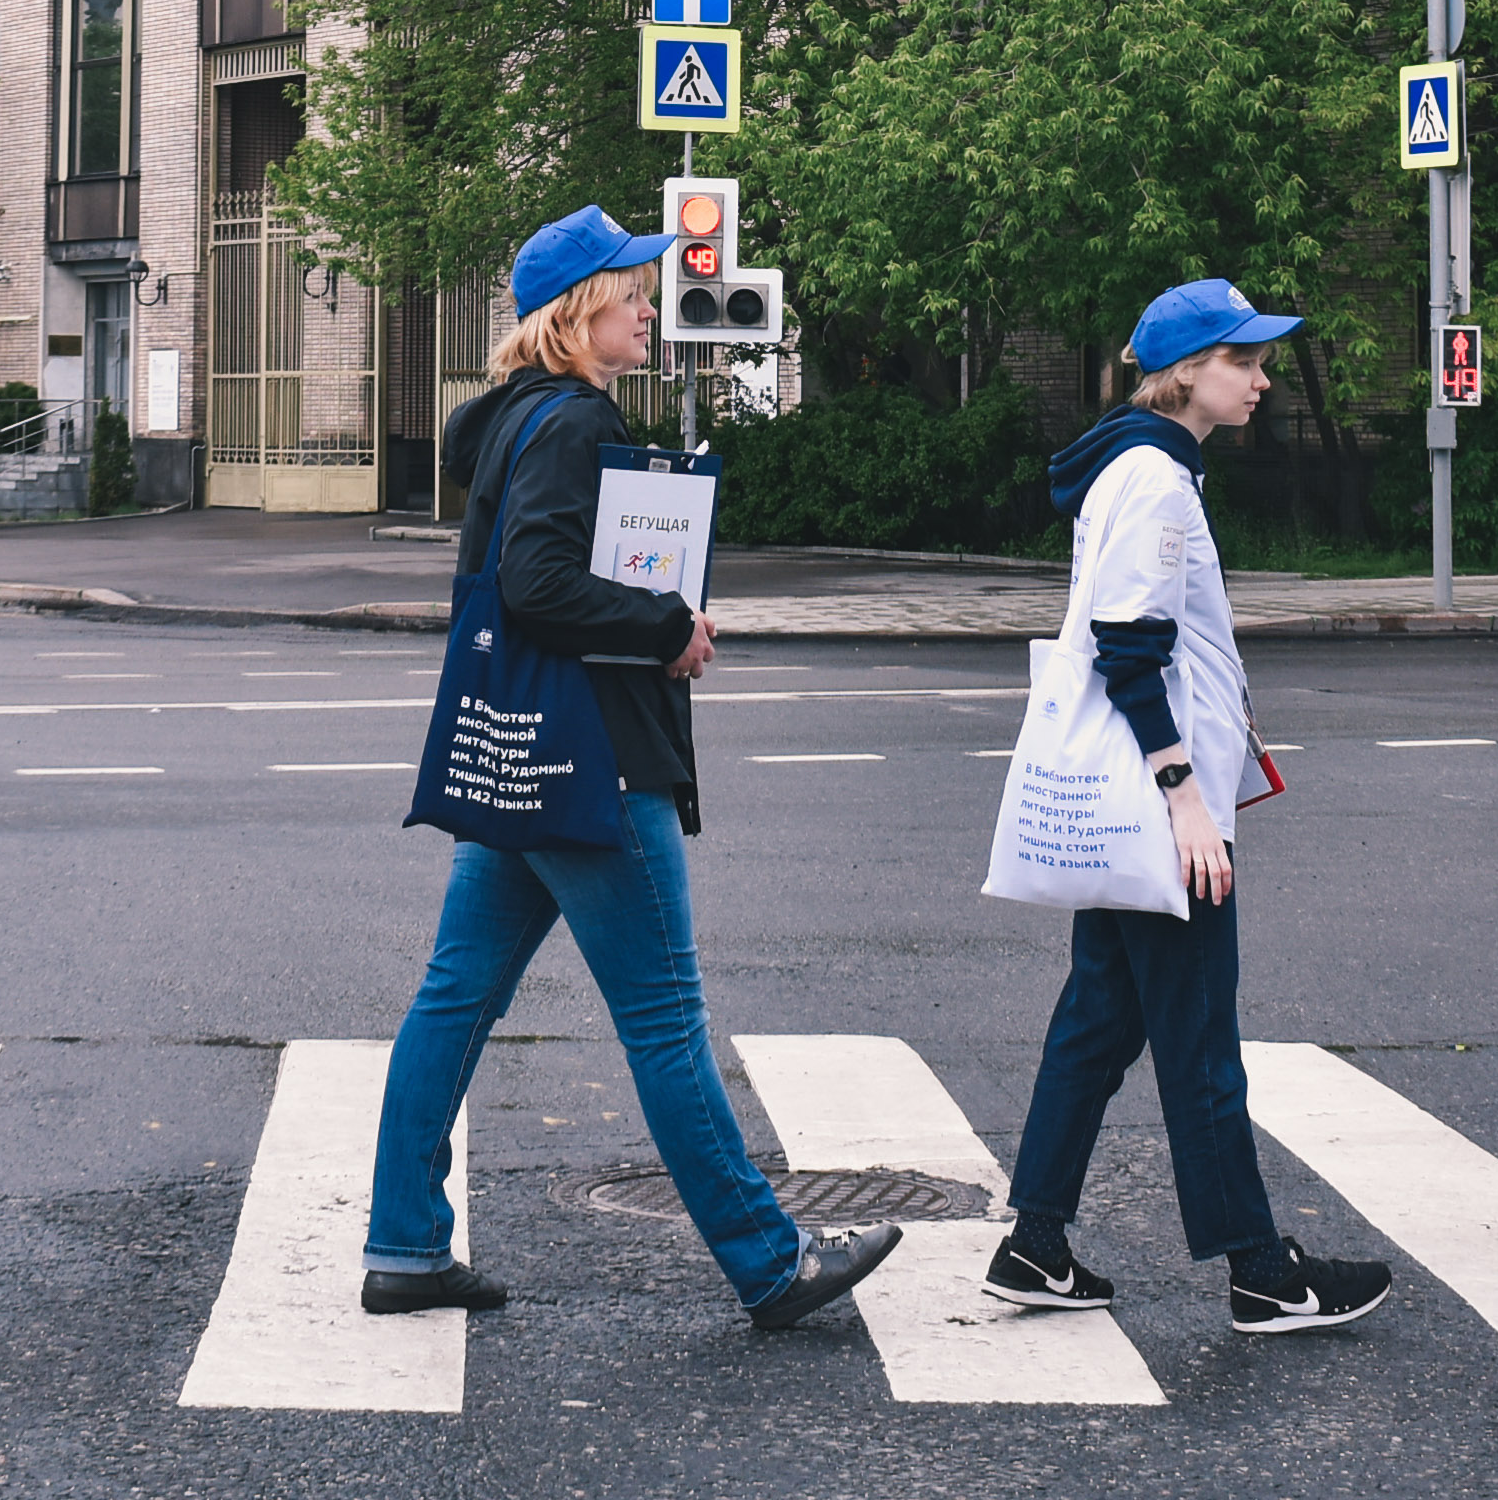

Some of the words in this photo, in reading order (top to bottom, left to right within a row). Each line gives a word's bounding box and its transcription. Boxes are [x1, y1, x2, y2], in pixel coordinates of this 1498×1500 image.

[687, 250, 715, 273] 49
[1444, 368, 1478, 398] 49
[620, 515, 690, 533] БЕГУЩАЯ
[461, 695, 471, 708] В
[450, 750, 473, 764] им.
[1025, 763, 1032, 774] В
[444, 785, 462, 798] на
[466, 788, 491, 804] 142
[498, 782, 540, 793] стоит
[1022, 782, 1102, 801] иностранной
[1020, 799, 1095, 820] литературы
[1018, 817, 1035, 828] им.
[1018, 833, 1062, 851] тишина
[1066, 843, 1106, 852] стоит
[1018, 850, 1031, 861] на
[1035, 853, 1055, 866] 142
[1059, 859, 1110, 869] языках
